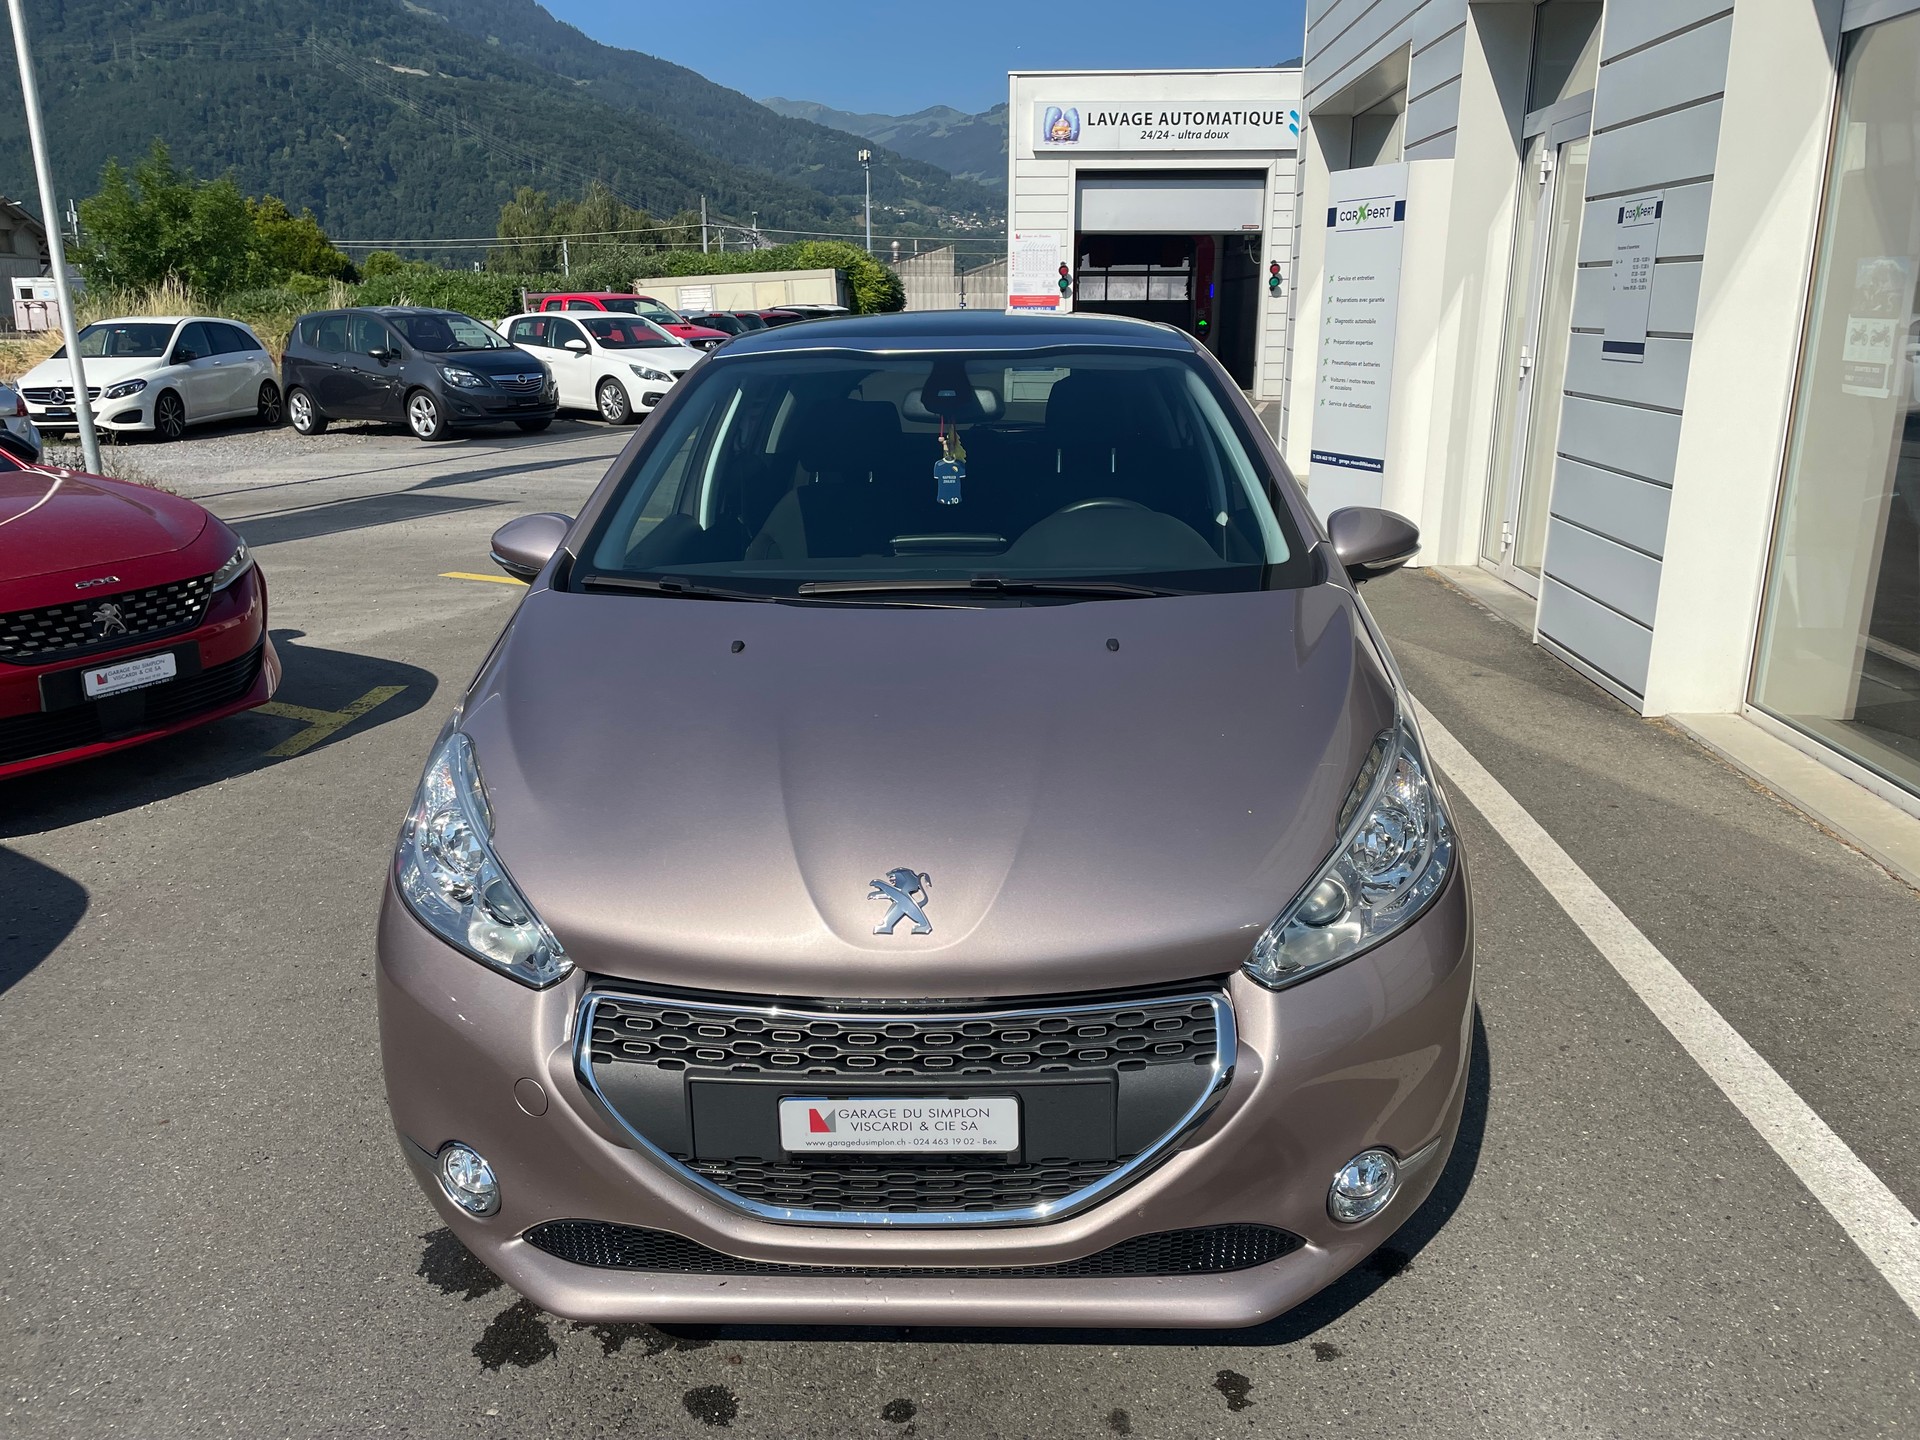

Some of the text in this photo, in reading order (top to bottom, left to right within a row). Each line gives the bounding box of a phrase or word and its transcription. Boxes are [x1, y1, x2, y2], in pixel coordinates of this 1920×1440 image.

[1088, 111, 1284, 127] LAVAGE AUTOMATIQUE
[1140, 130, 1169, 140] 24/24
[1178, 129, 1202, 139] ultra
[1204, 129, 1230, 139] doux
[1348, 402, 1372, 410] climatisation
[107, 667, 130, 677] GARAGE
[142, 659, 165, 669] SIMPLON
[112, 671, 138, 681] VISCARDI
[838, 1108, 990, 1119] GARAGE DU SIMPLON
[850, 1121, 979, 1132] VISCARDI & CIE SA
[805, 1138, 906, 1148] www.garagedusimplon.ch
[913, 1138, 931, 1146] 024
[932, 1138, 949, 1146] 463
[952, 1138, 961, 1146] 19
[963, 1138, 975, 1146] 02
[982, 1138, 997, 1146] Bex
